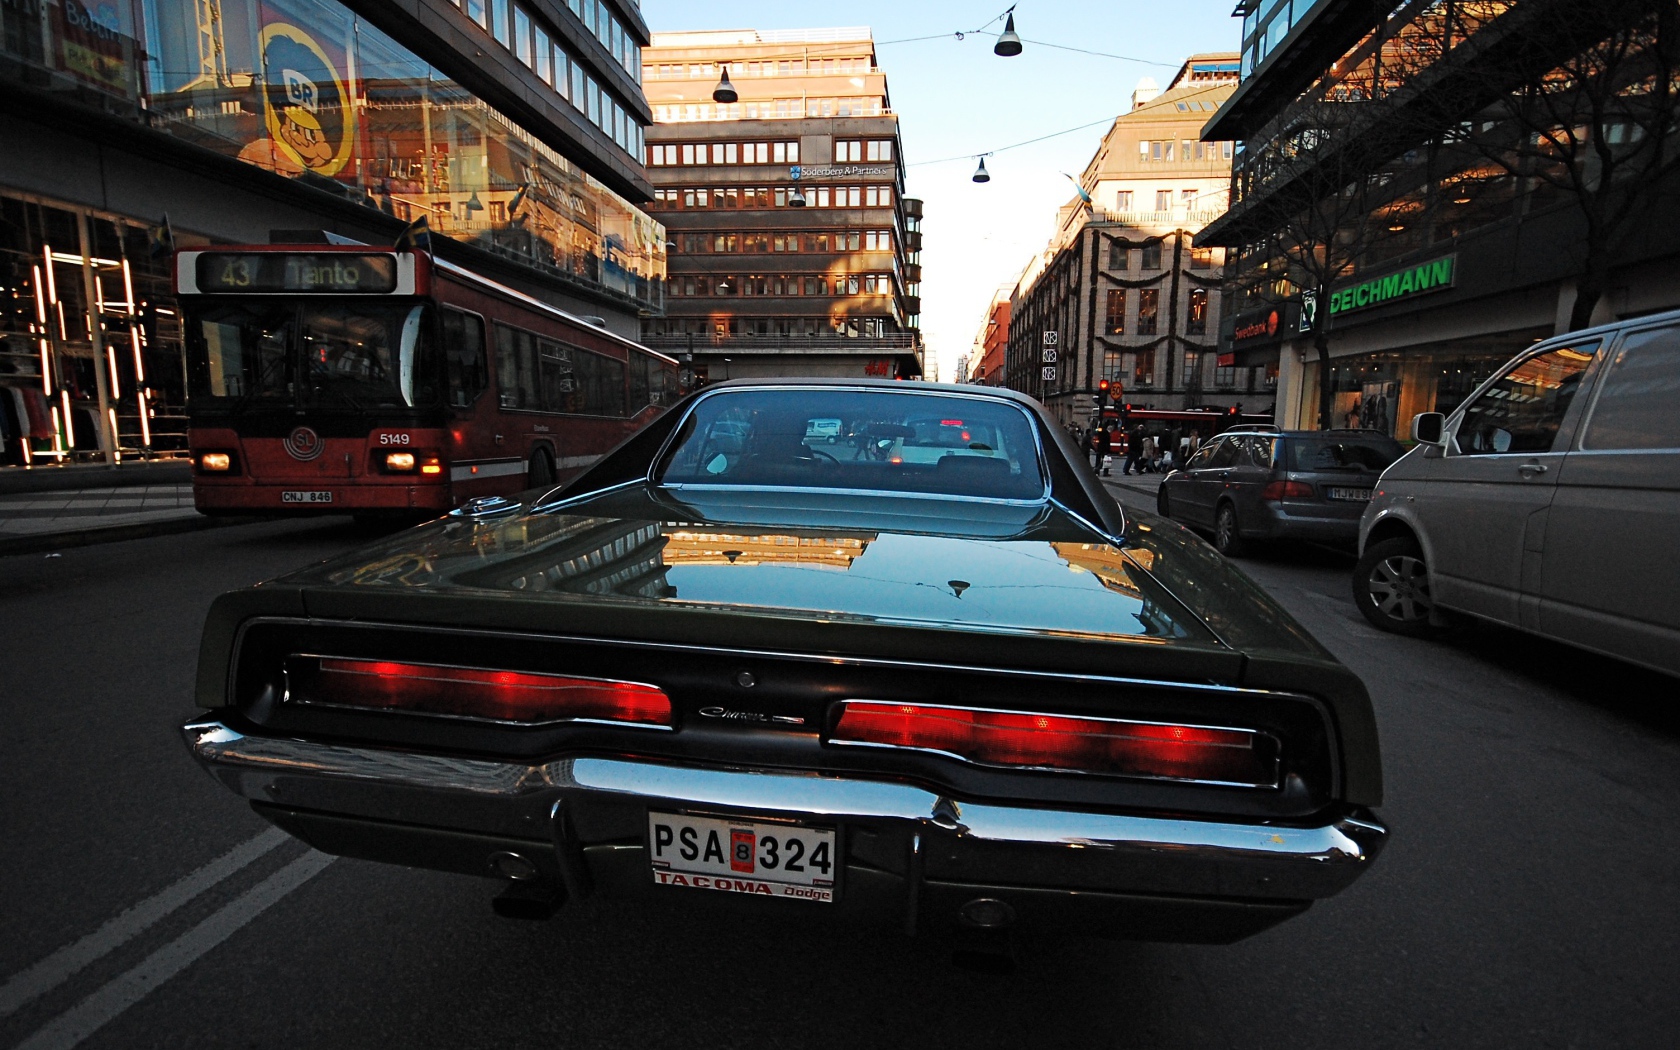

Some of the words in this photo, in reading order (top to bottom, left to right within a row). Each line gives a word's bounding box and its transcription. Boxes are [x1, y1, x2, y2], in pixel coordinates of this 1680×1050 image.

[290, 77, 313, 107] BR
[801, 166, 843, 178] Söderberg
[844, 166, 851, 174] &
[852, 166, 887, 175] Partners
[221, 260, 250, 286] 43
[288, 261, 360, 285] Tanto
[1329, 257, 1453, 315] DEICHMANN
[1235, 321, 1267, 340] Swedbank
[1111, 384, 1120, 396] 50
[296, 433, 313, 447] SL
[380, 433, 410, 445] 5149
[284, 492, 303, 502] CNJ
[311, 492, 331, 502] 846
[1334, 488, 1354, 498] MJW
[655, 824, 725, 864] PSA
[736, 844, 749, 860] 8
[759, 835, 831, 875] 324
[656, 872, 773, 894] TACOMA
[784, 886, 830, 901] Dodge
